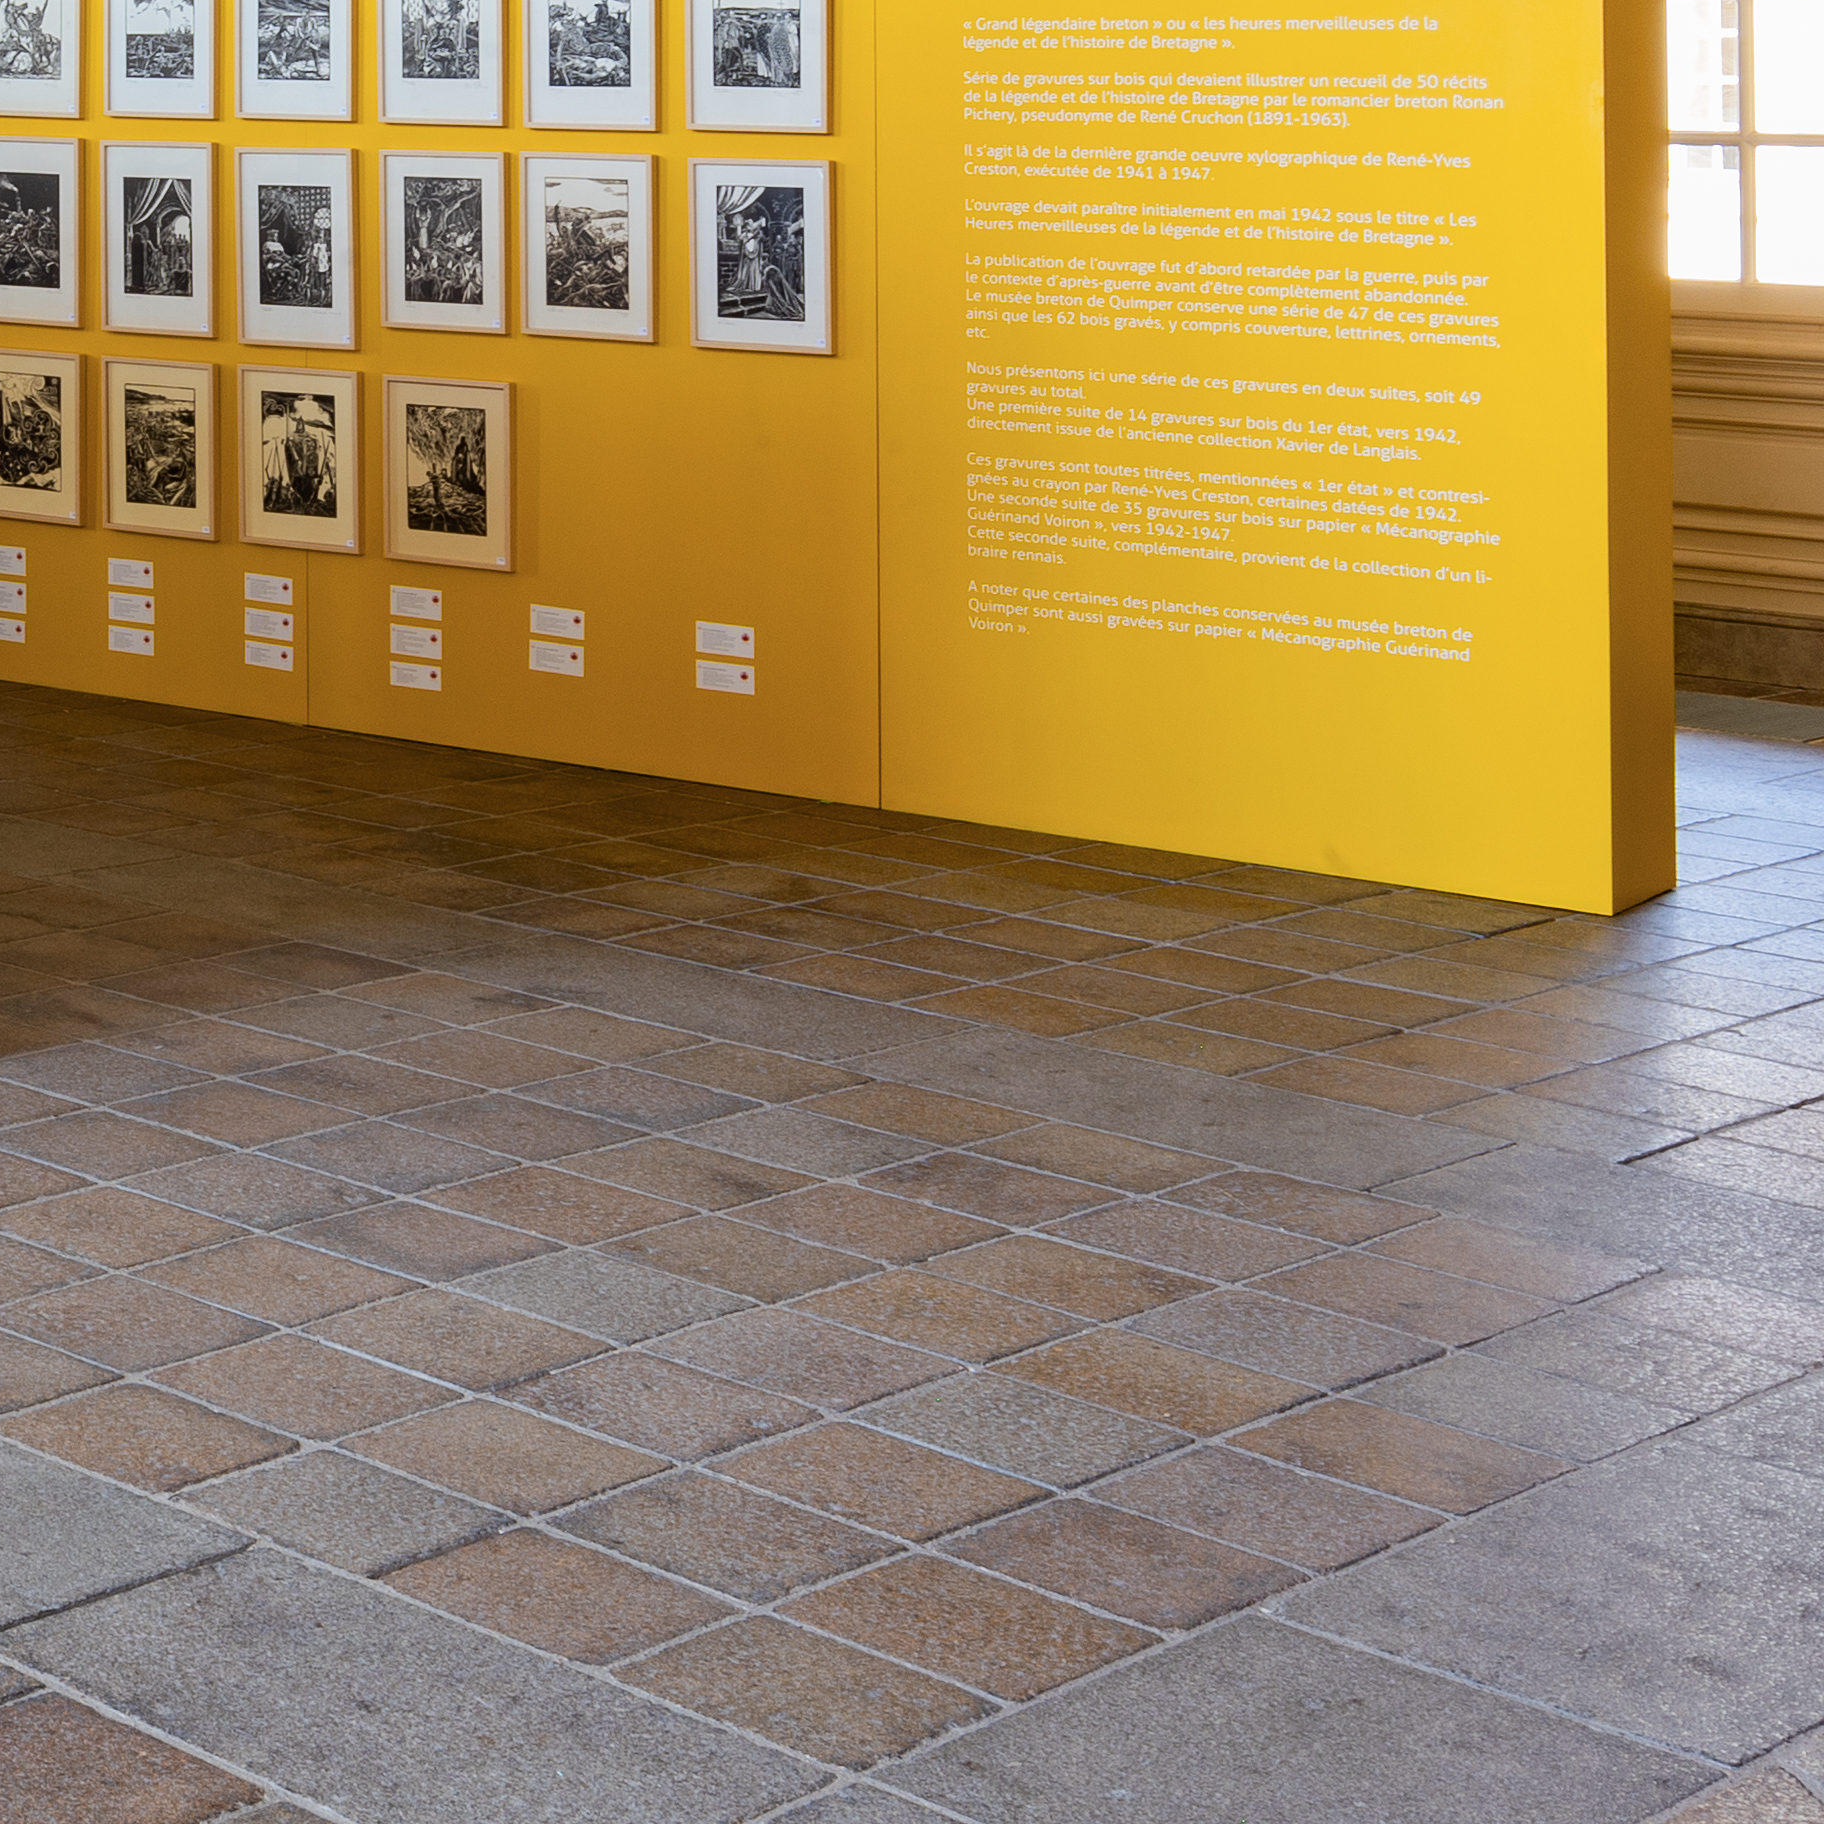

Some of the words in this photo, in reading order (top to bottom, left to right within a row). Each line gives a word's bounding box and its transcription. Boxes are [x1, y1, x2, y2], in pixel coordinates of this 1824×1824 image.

[963, 70, 998, 84] Série
[1002, 71, 1020, 84] de
[1023, 74, 1084, 88] gravures
[1088, 75, 1110, 85] sur
[1114, 71, 1145, 85] bois
[1148, 73, 1172, 88] qui
[1176, 72, 1242, 86] devaient
[1246, 72, 1305, 87] illustrer
[1308, 76, 1330, 87] un
[1333, 73, 1388, 88] recueil
[1391, 73, 1412, 88] de
[1417, 73, 1439, 88] 50
[1442, 74, 1488, 89] récits
[963, 89, 981, 102] de
[985, 89, 997, 102] la
[1001, 89, 1057, 106] légende
[1061, 92, 1075, 103] et
[1079, 90, 1097, 103] de
[1169, 91, 1188, 105] de
[1192, 91, 1258, 109] Bretagne
[1263, 95, 1287, 109] par
[1292, 92, 1307, 106] le
[1311, 93, 1390, 107] romancier
[1394, 93, 1449, 108] breton
[1452, 93, 1505, 109] Ronan
[1021, 108, 1113, 125] pseudonyme
[1117, 109, 1136, 123] de
[1140, 109, 1177, 123] René
[1180, 109, 1244, 124] Cruchon
[964, 144, 972, 156] Il
[1016, 145, 1029, 157] là
[1032, 145, 1050, 158] de
[1054, 145, 1067, 158] la
[1070, 145, 1132, 159] dernière
[1135, 148, 1187, 163] grande
[1190, 151, 1243, 162] oeuvre
[1247, 149, 1358, 168] xylographique
[1361, 151, 1383, 166] de
[1386, 151, 1471, 168] René-Yves
[1024, 163, 1089, 177] exécutée
[1092, 165, 1111, 178] de
[1116, 165, 1153, 179] 1941
[1158, 166, 1167, 179] à
[966, 253, 980, 265] La
[985, 254, 1063, 268] publication
[1068, 256, 1086, 269] de
[1160, 259, 1181, 273] fut
[1246, 265, 1311, 279] retardée
[1315, 269, 1340, 282] par
[1345, 267, 1359, 281] la
[1423, 271, 1458, 287] puis
[1462, 275, 1489, 289] par
[966, 271, 978, 283] le
[982, 274, 1042, 286] contexte
[1155, 281, 1196, 293] avant
[1247, 284, 1360, 300] complètement
[966, 289, 981, 301] Le
[986, 291, 1031, 304] musée
[1036, 292, 1082, 306] breton
[1086, 294, 1104, 307] de
[1109, 294, 1173, 312] Quimper
[1176, 300, 1244, 314] conserve
[1248, 304, 1277, 316] une
[1282, 303, 1319, 318] série
[1324, 305, 1343, 319] de
[1348, 306, 1369, 319] 47
[1374, 307, 1394, 322] de
[1398, 311, 1425, 323] ces
[1429, 313, 1500, 327] gravures
[966, 382, 1025, 395] gravures
[1030, 386, 1046, 396] au
[967, 416, 1051, 433] directement
[1056, 422, 1091, 436] issue
[1096, 425, 1114, 438] de
[1198, 432, 1272, 449] collection
[1276, 437, 1324, 453] Xavier
[1328, 441, 1349, 455] de
[967, 473, 1008, 486] gnées
[1012, 476, 1028, 487] au
[1033, 478, 1080, 493] crayon
[1084, 482, 1107, 494] par
[1112, 481, 1188, 500] René-Yves
[1257, 496, 1327, 511] certaines
[1332, 499, 1385, 516] datées
[1389, 503, 1410, 518] de
[968, 525, 1004, 540] Cette
[1009, 531, 1067, 545] seconde
[1242, 552, 1305, 567] provient
[1310, 555, 1330, 570] de
[1334, 557, 1348, 571] la
[1352, 560, 1431, 578] collection
[1476, 569, 1492, 583] li-
